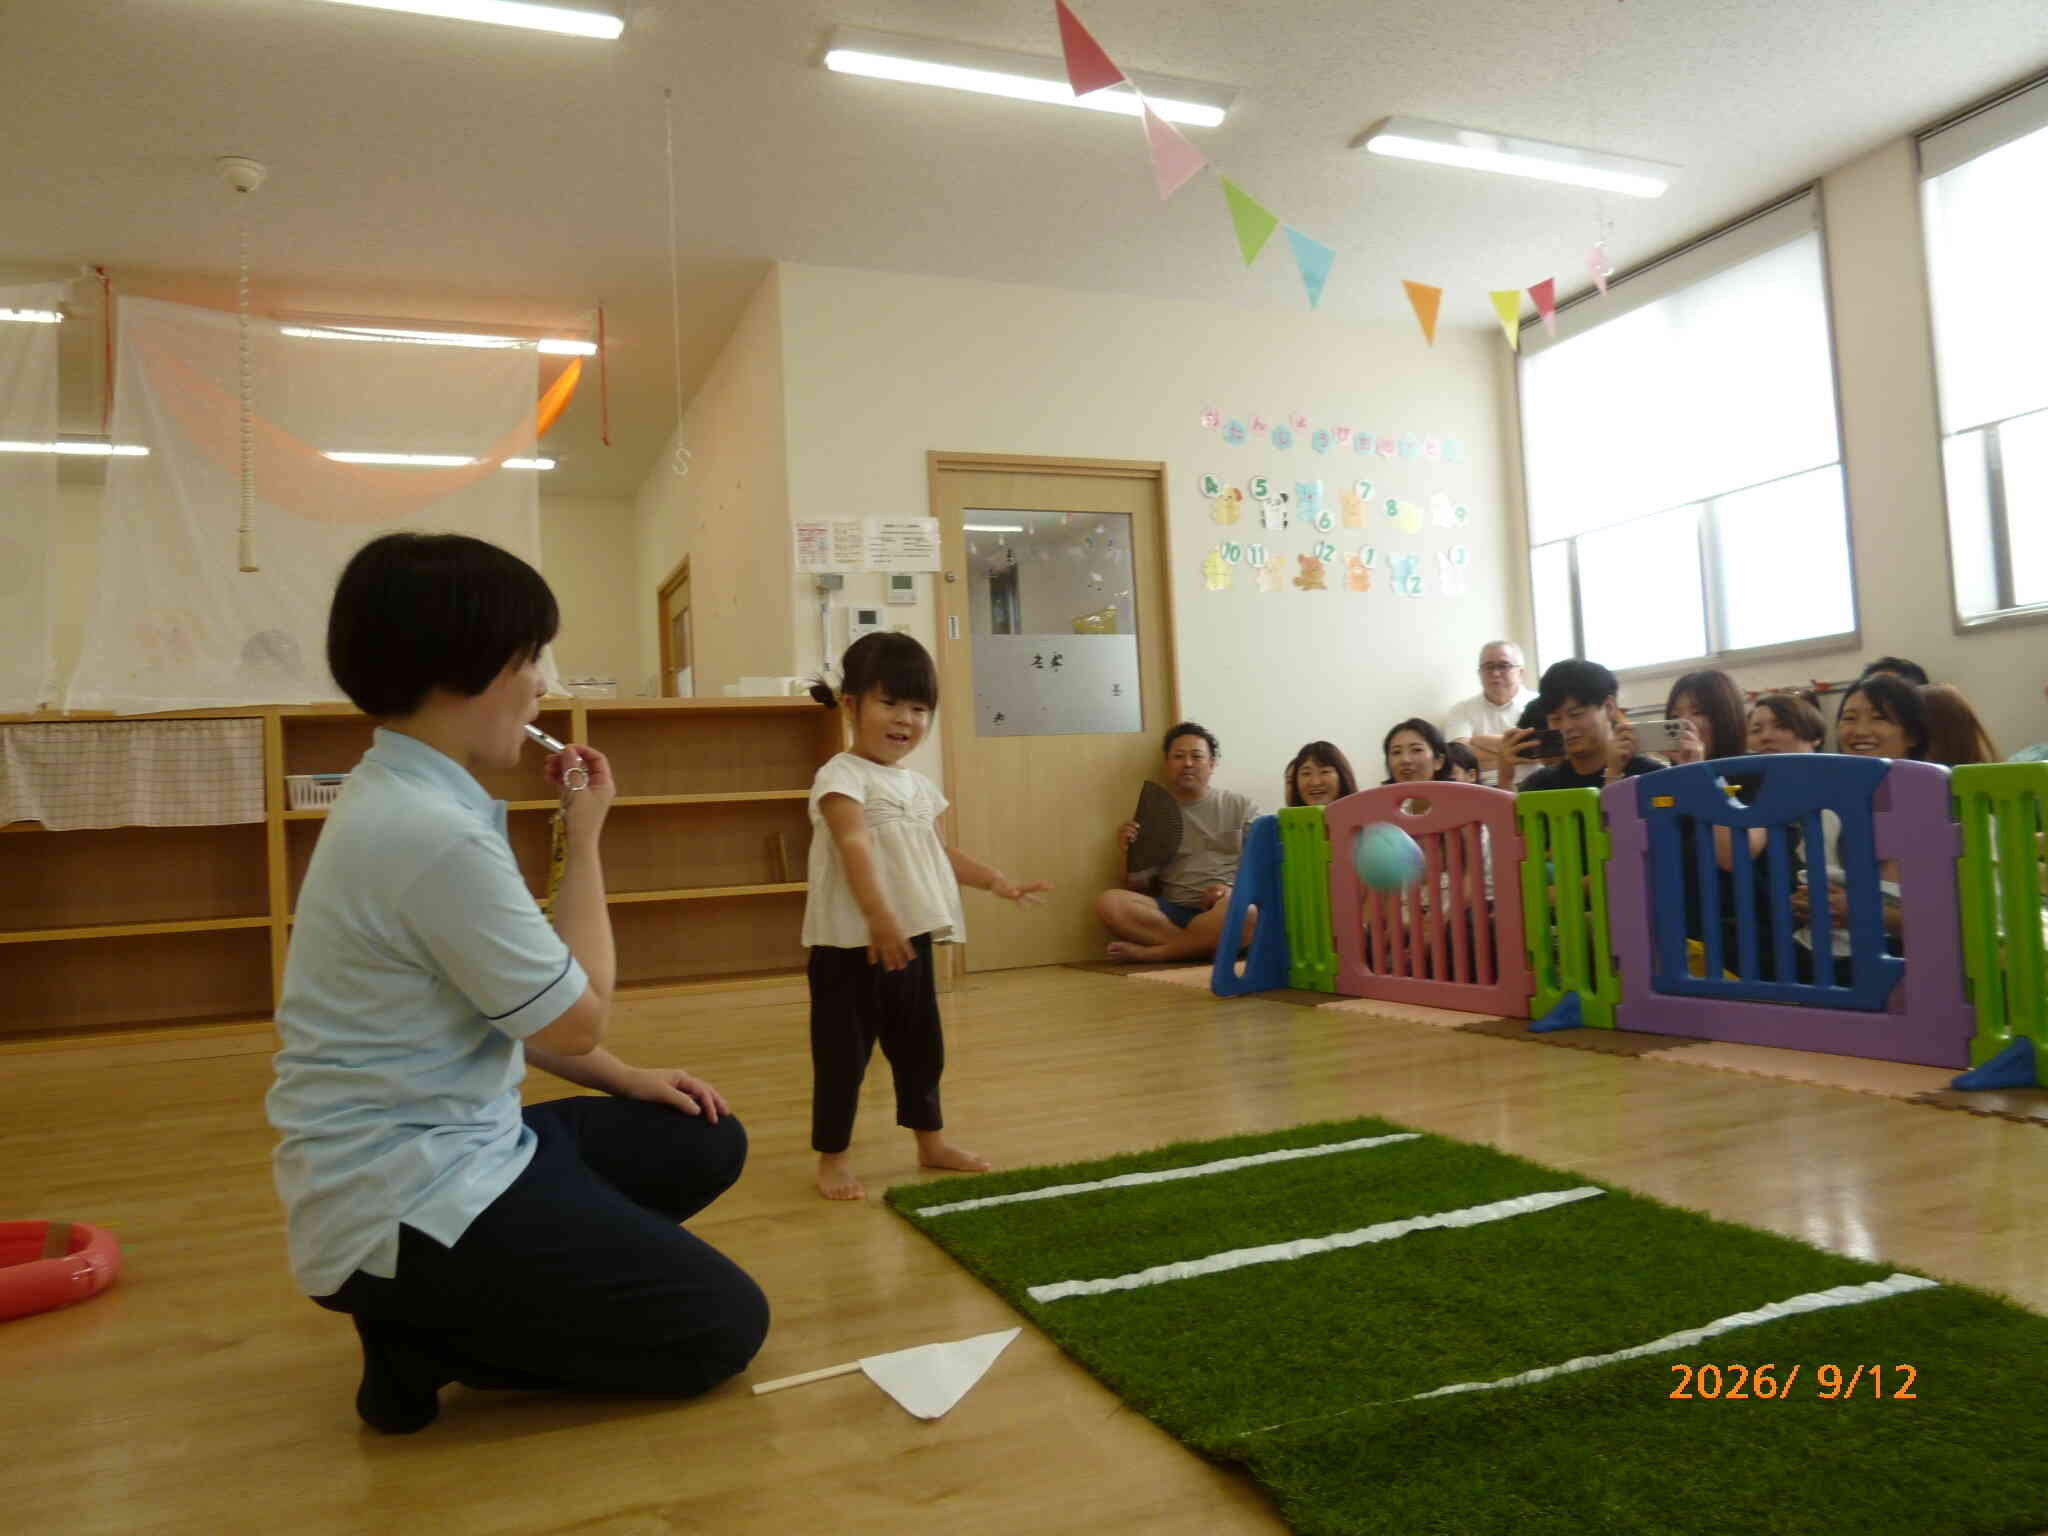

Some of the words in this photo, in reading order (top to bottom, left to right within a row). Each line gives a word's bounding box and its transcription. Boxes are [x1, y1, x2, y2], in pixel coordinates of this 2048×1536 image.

[1203, 476, 1219, 494] 4
[1255, 478, 1268, 497] 5
[1359, 481, 1373, 499] 7
[1385, 499, 1398, 516] 8
[1454, 506, 1467, 524] 9
[1318, 511, 1332, 530] 6
[1223, 543, 1241, 563] 10
[1250, 546, 1266, 565] 11
[1315, 542, 1336, 563] 12
[1410, 576, 1422, 594] 2
